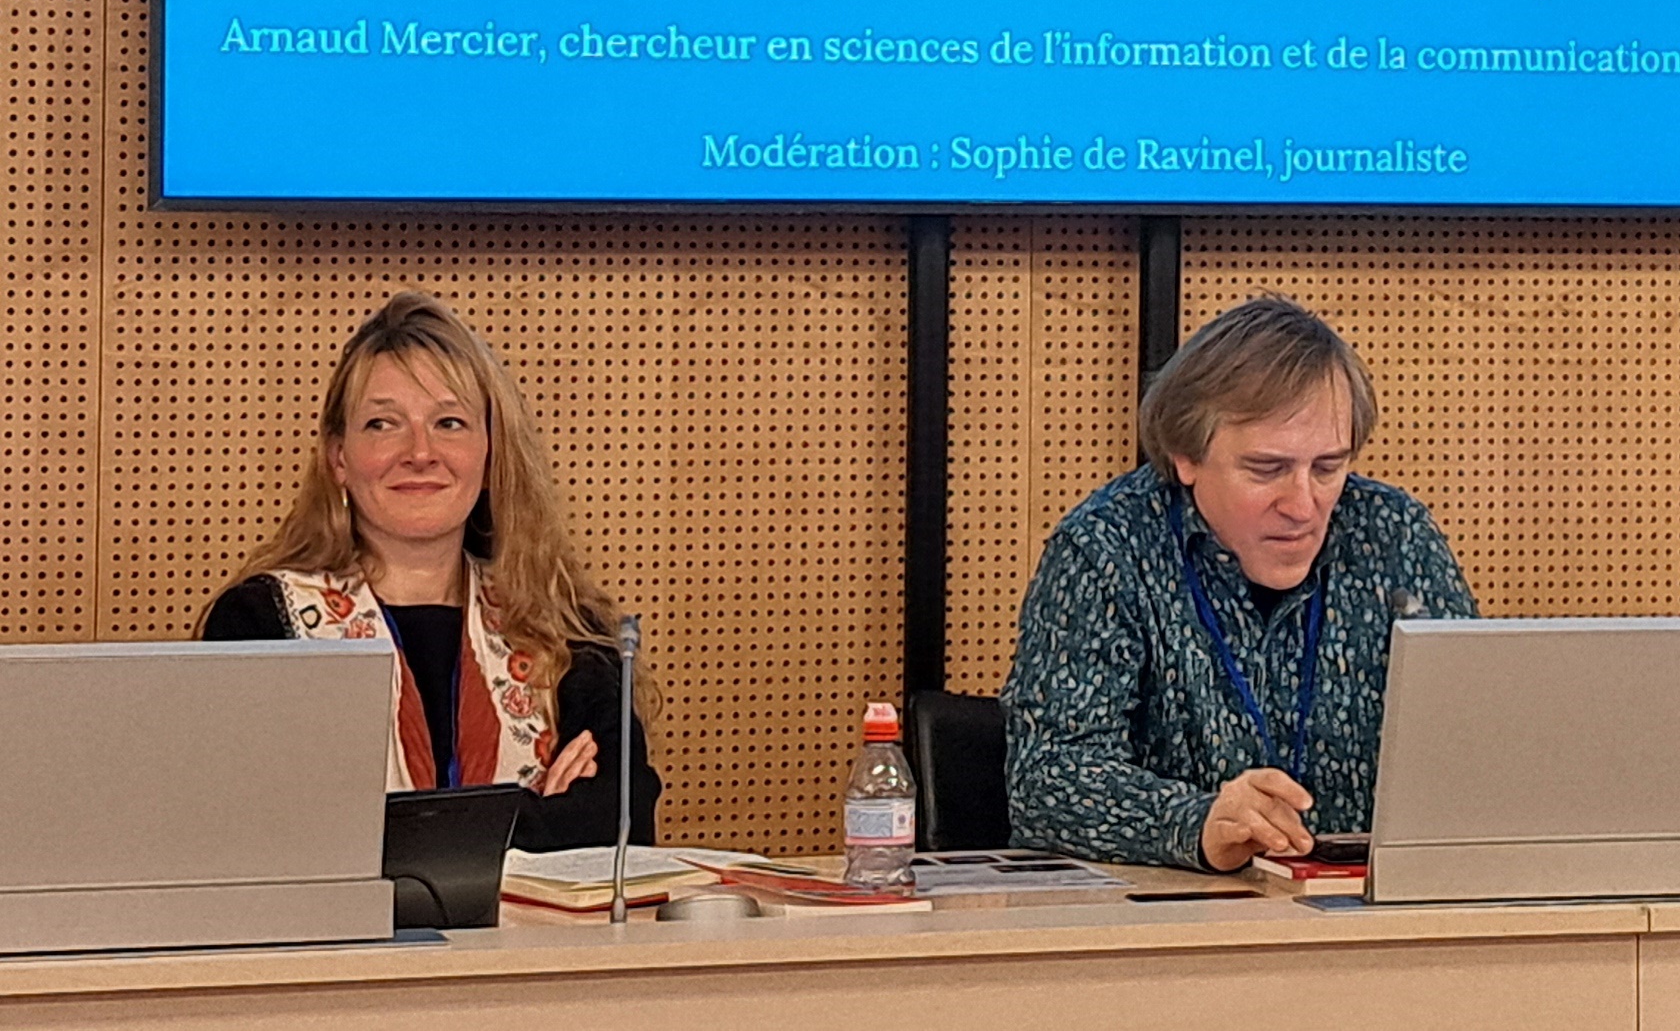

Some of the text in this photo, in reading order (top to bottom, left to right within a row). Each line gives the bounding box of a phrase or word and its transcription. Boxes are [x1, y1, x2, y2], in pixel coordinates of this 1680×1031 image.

[220, 19, 368, 57] Arnaud
[381, 22, 548, 63] Mercier,
[558, 26, 756, 63] chercheur
[766, 36, 813, 64] en
[822, 30, 980, 67] sciences
[990, 33, 1034, 67] de
[1281, 41, 1319, 71] et
[1326, 37, 1368, 72] de
[1378, 39, 1408, 72] la
[701, 136, 1468, 182] Modération : Sophie de Ravinel, journaliste
